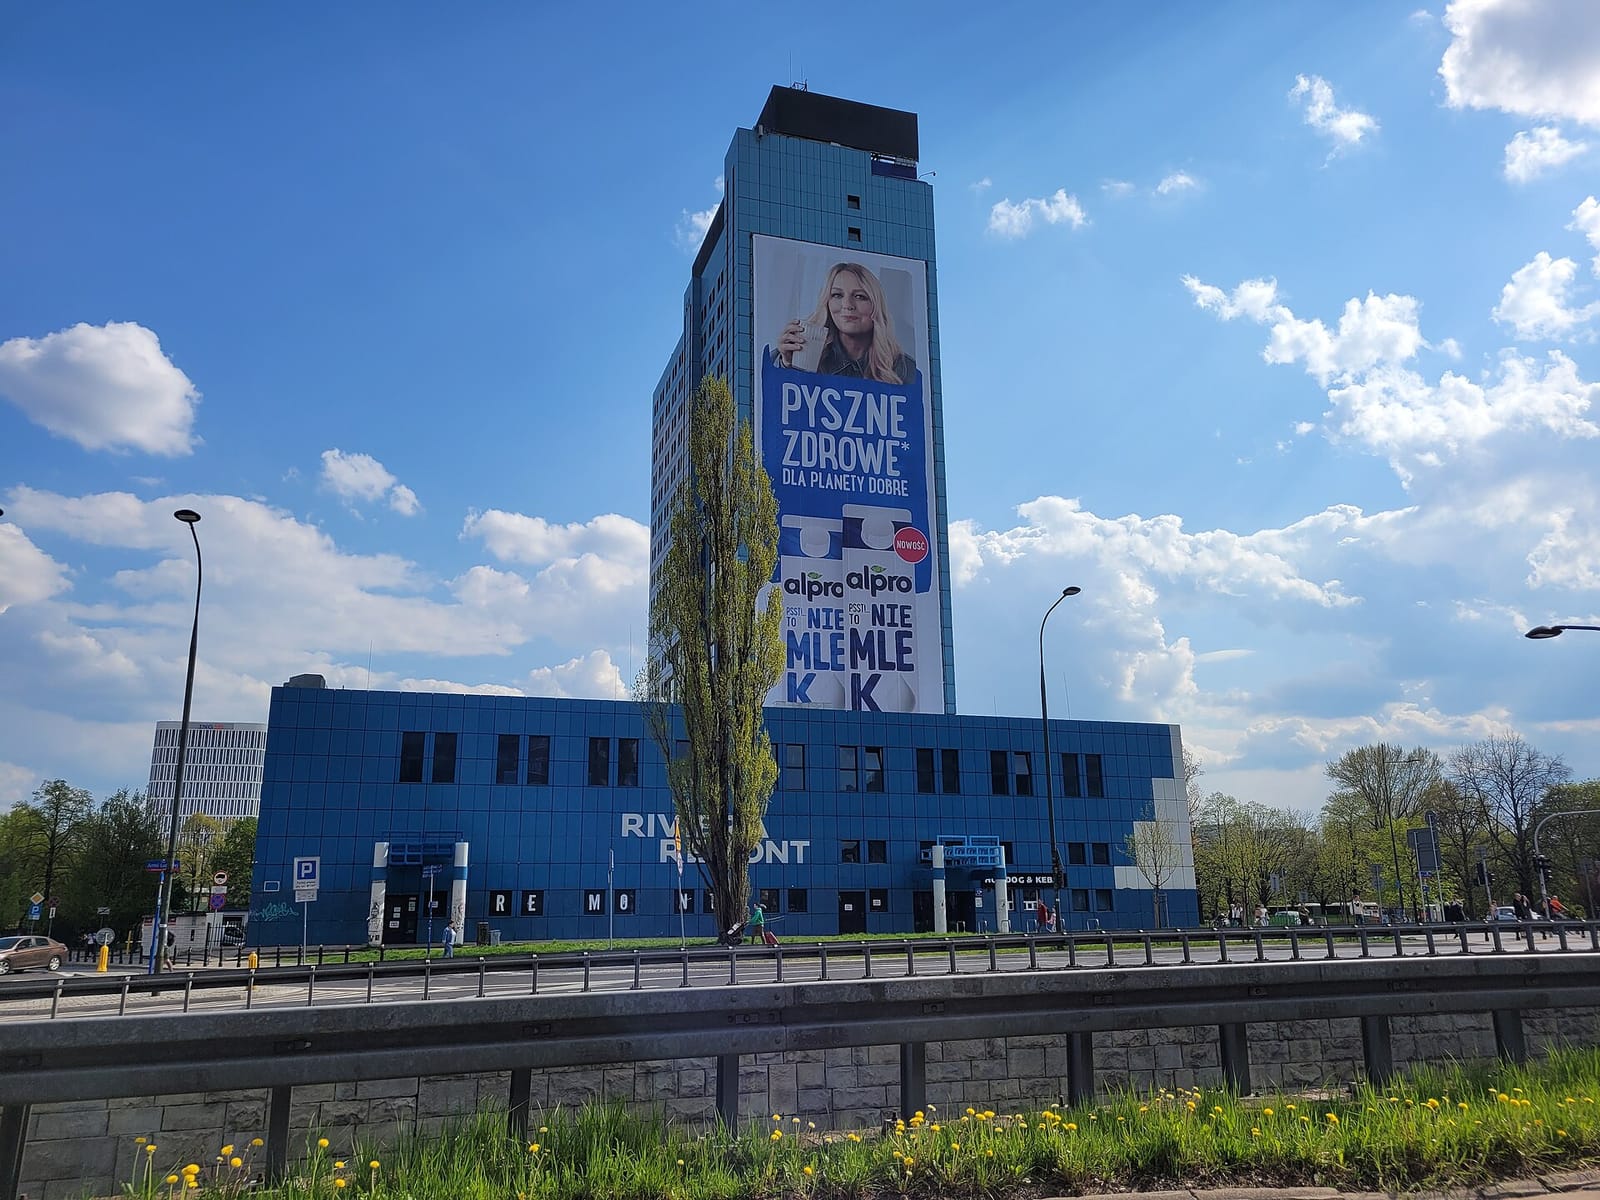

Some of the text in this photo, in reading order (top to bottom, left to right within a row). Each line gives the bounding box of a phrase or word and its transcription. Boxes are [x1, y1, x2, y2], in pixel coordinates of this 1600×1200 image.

[781, 382, 908, 439] PYSZNE
[782, 468, 909, 497] DLA PLANETY DOBRE
[783, 572, 844, 602] alpro
[846, 565, 913, 597] alpro
[786, 616, 797, 627] TO
[807, 607, 845, 631] NIE
[849, 613, 860, 625] TO
[871, 603, 913, 628] NIE
[786, 629, 845, 672] MLE
[850, 628, 915, 672] MLE
[787, 672, 817, 704] K
[851, 672, 883, 711] K
[301, 862, 313, 878] P
[1026, 876, 1033, 884] &
